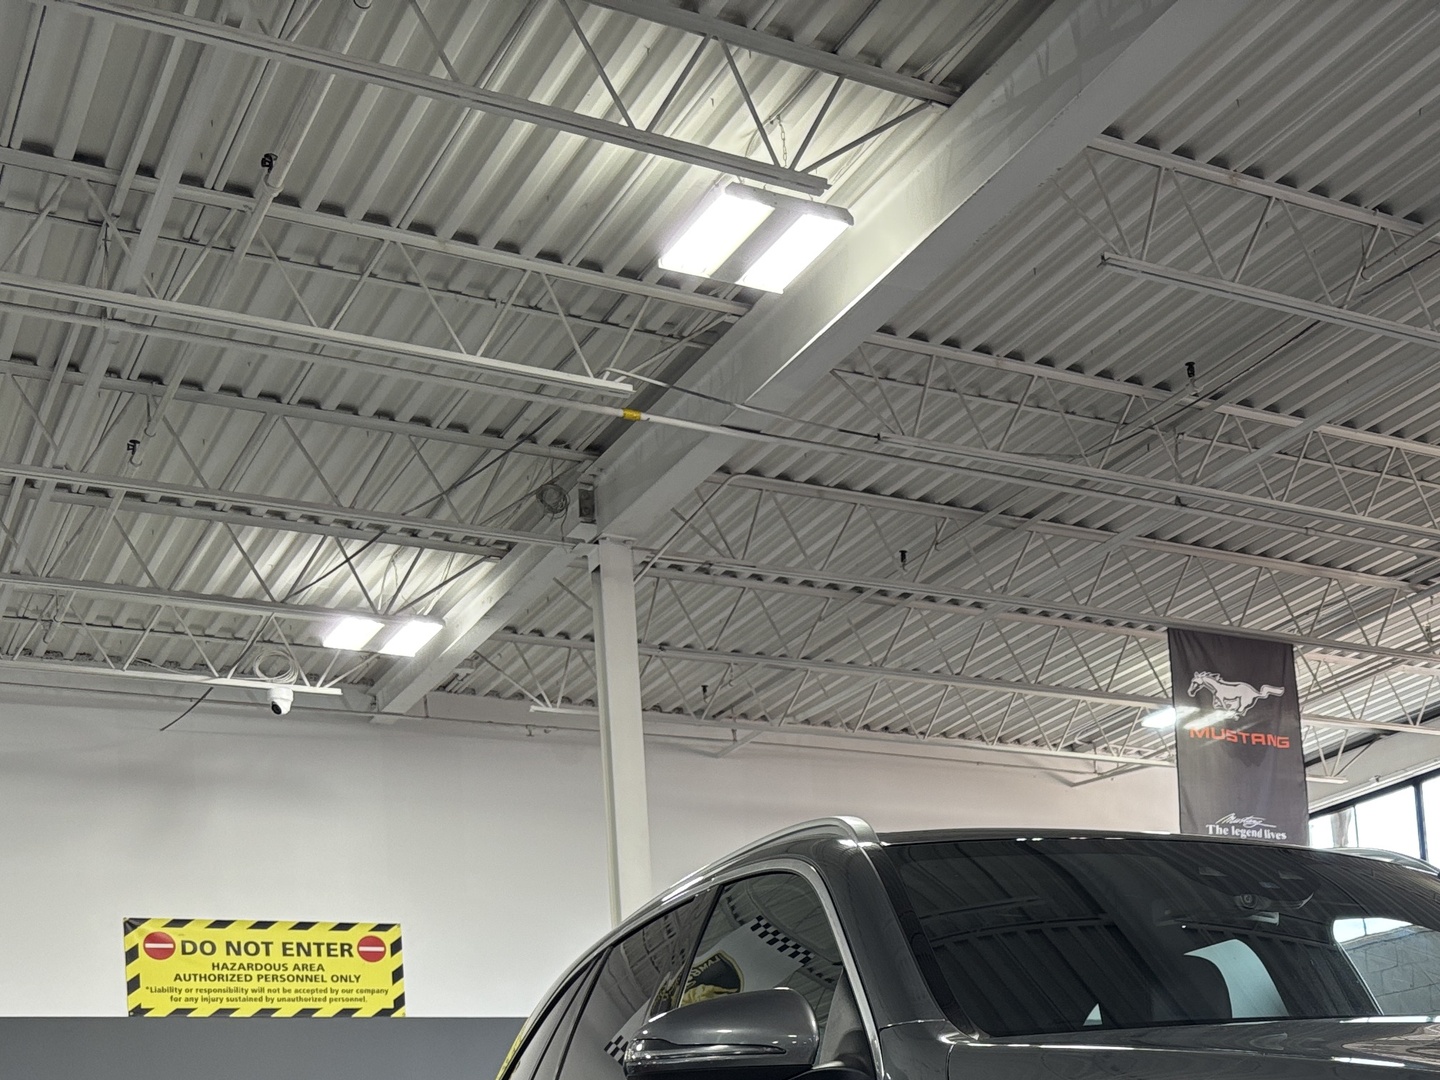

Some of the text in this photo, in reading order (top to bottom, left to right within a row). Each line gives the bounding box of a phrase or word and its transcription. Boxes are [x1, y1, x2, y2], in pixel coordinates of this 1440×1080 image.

[1190, 726, 1290, 749] MUSTANG
[1205, 824, 1287, 840] The legend lives
[180, 940, 354, 958] DO NOT ENTER
[211, 962, 326, 972] HAZARDOUS AREA
[173, 973, 362, 984] AUTHORIZED PERSONNEL ONLY
[195, 986, 249, 996] responsibility
[250, 986, 266, 994] will
[282, 986, 292, 994] be
[293, 986, 328, 996] accepted
[329, 986, 339, 996] by
[340, 987, 354, 995] our
[355, 987, 389, 996] company
[170, 994, 183, 1003] for
[184, 996, 199, 1004] any
[200, 994, 224, 1004] injury
[225, 994, 264, 1003] sustained
[265, 994, 275, 1004] by
[276, 994, 324, 1003] unauthorized
